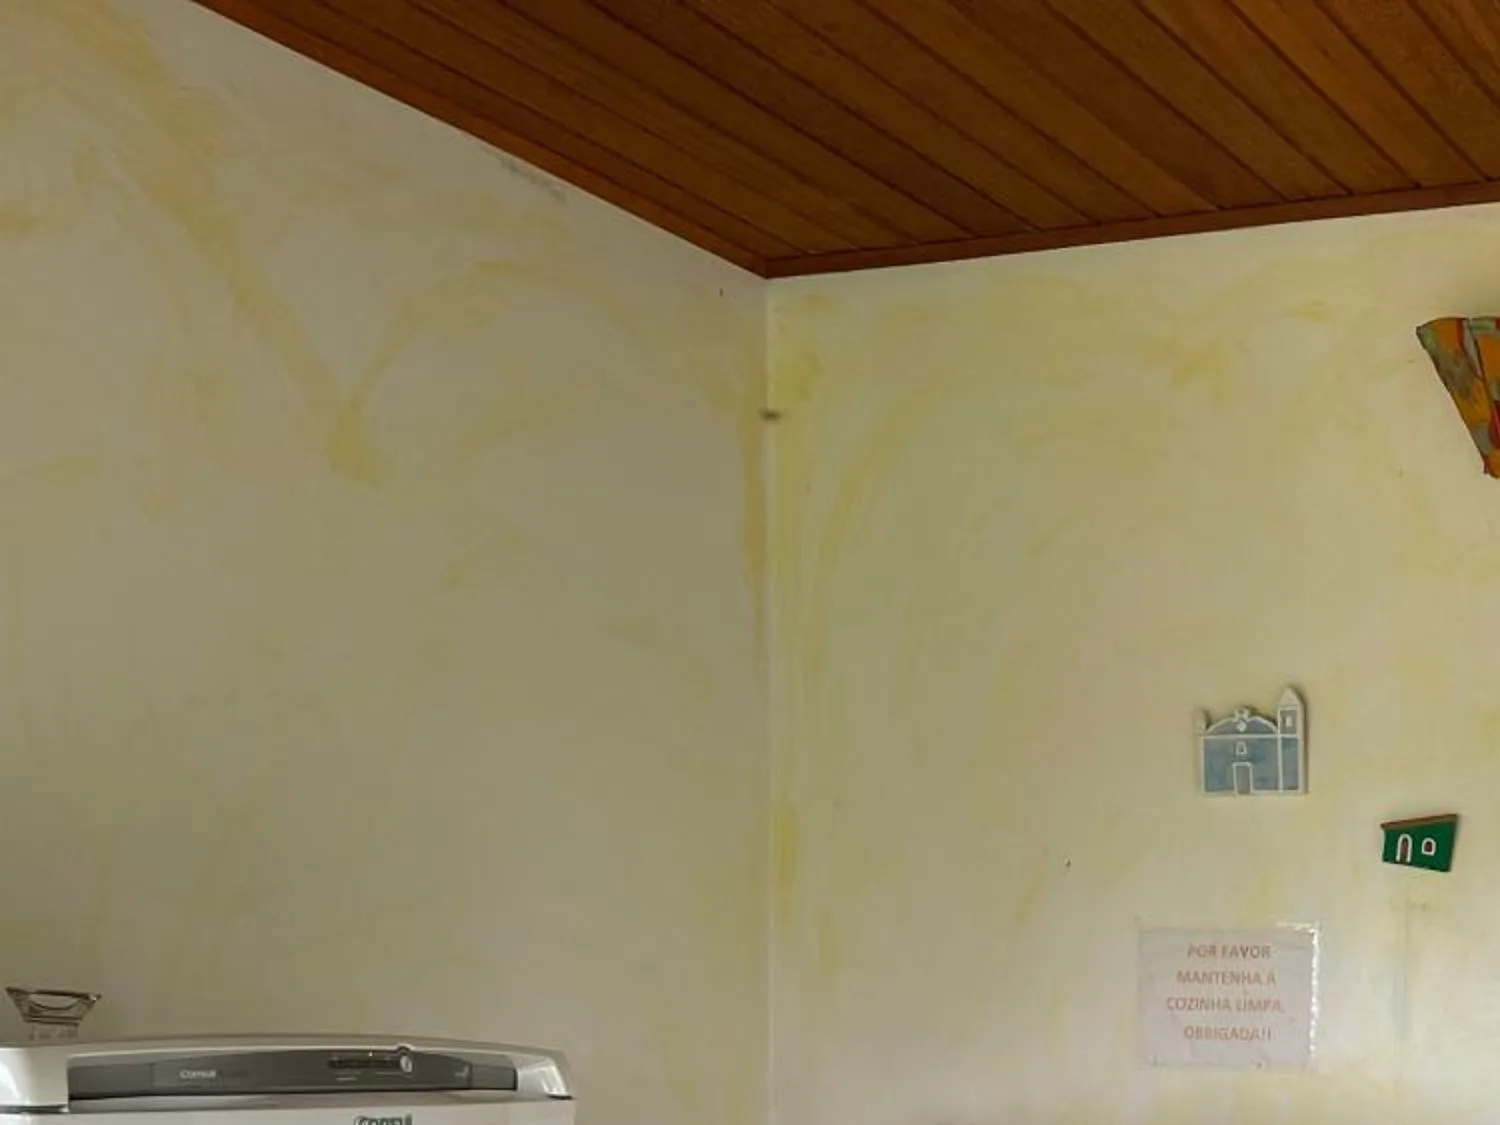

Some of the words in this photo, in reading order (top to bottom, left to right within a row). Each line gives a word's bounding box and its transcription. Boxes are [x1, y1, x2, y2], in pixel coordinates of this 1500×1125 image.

[1187, 944, 1217, 958] POR
[1221, 944, 1272, 959] FAVOR
[1176, 970, 1262, 985] MANTENHA
[1166, 997, 1232, 1012] COZINHA
